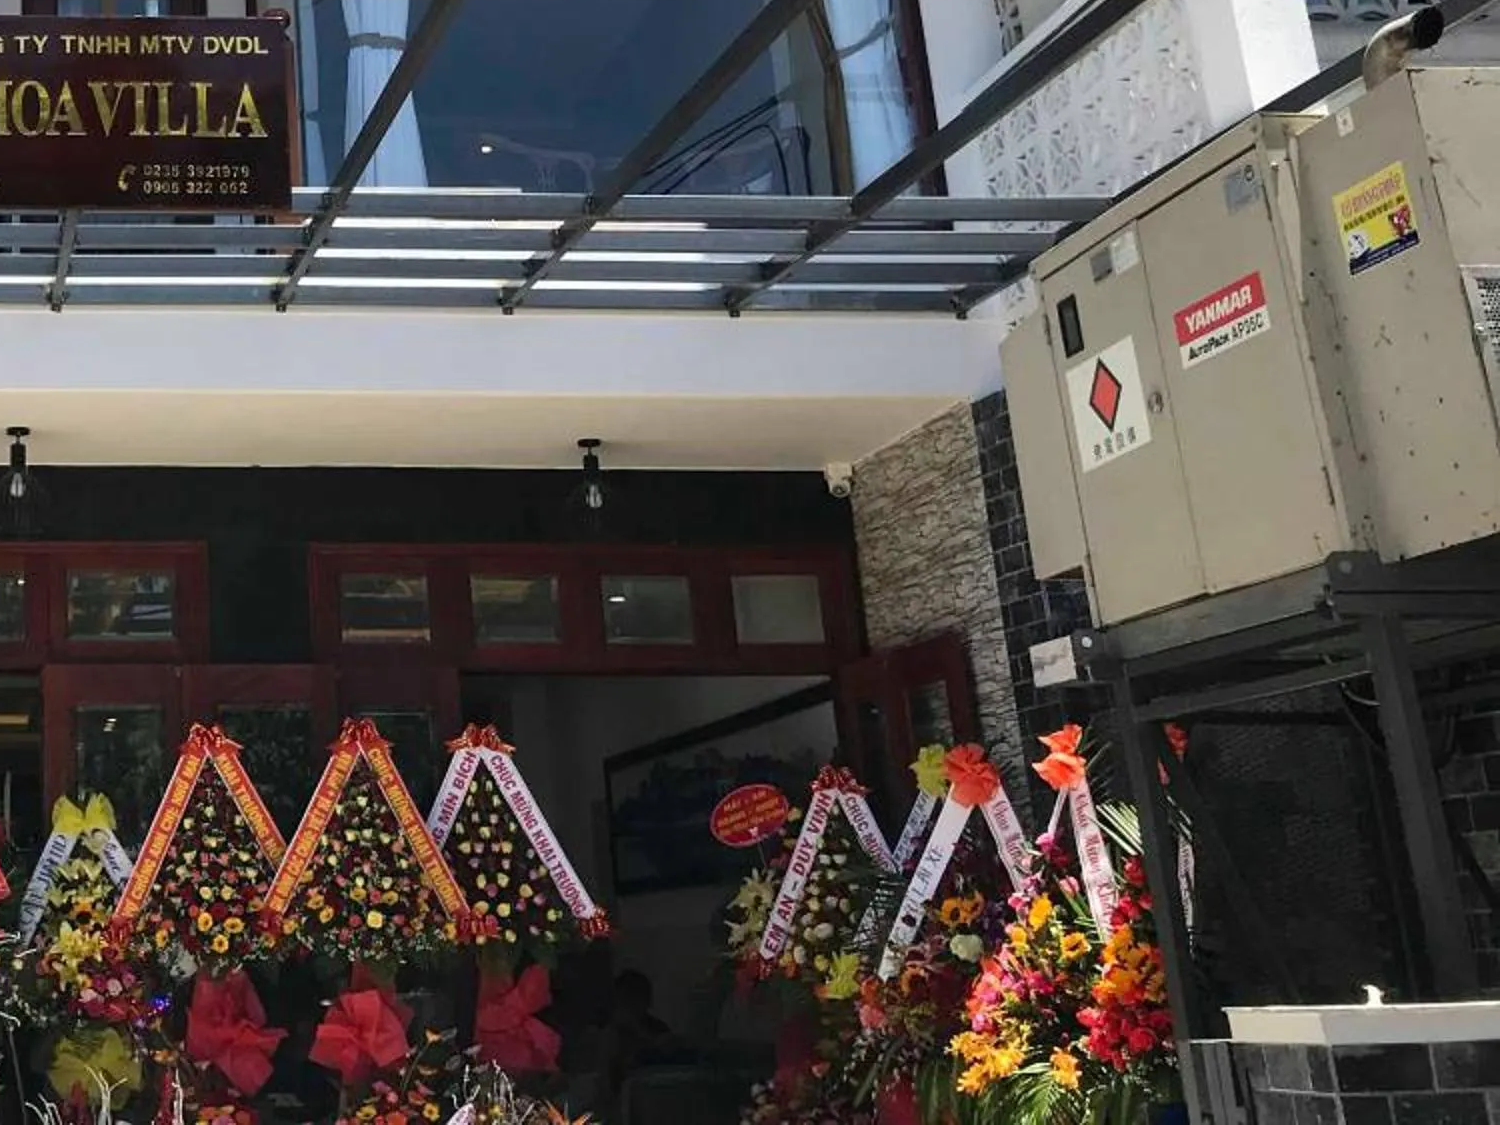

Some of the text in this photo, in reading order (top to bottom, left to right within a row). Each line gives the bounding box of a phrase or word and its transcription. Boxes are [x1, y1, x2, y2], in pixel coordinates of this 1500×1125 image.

[14, 35, 49, 54] TY
[61, 35, 131, 54] TNHH
[140, 36, 194, 54] MTV
[203, 36, 269, 55] DVDL
[88, 80, 269, 137] VILLA
[186, 181, 214, 194] 322
[1185, 284, 1253, 335] YANMAR
[530, 828, 558, 862] KHAI
[762, 922, 786, 953] EM
[774, 894, 796, 921] AN
[790, 837, 817, 875] DUY
[804, 791, 834, 835] VINH
